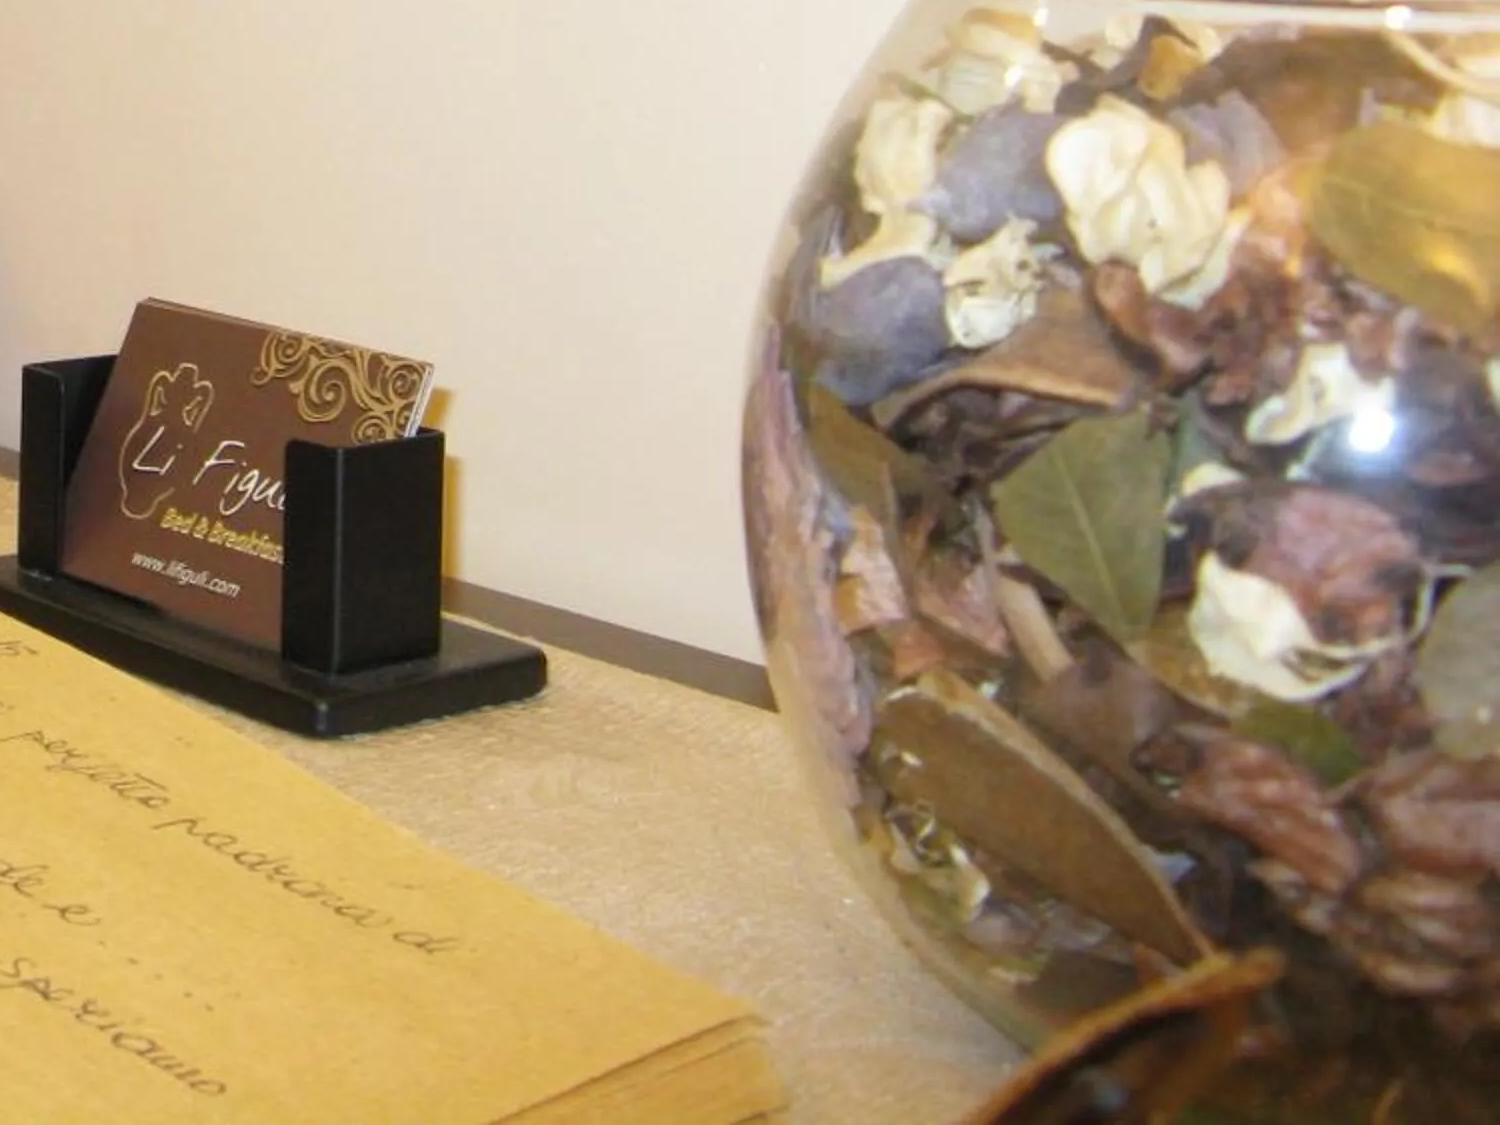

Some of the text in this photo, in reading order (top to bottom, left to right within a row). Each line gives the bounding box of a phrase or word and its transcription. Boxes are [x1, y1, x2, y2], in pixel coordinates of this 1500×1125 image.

[132, 425, 286, 516] Li Figu
[207, 520, 285, 566] Breakfas
